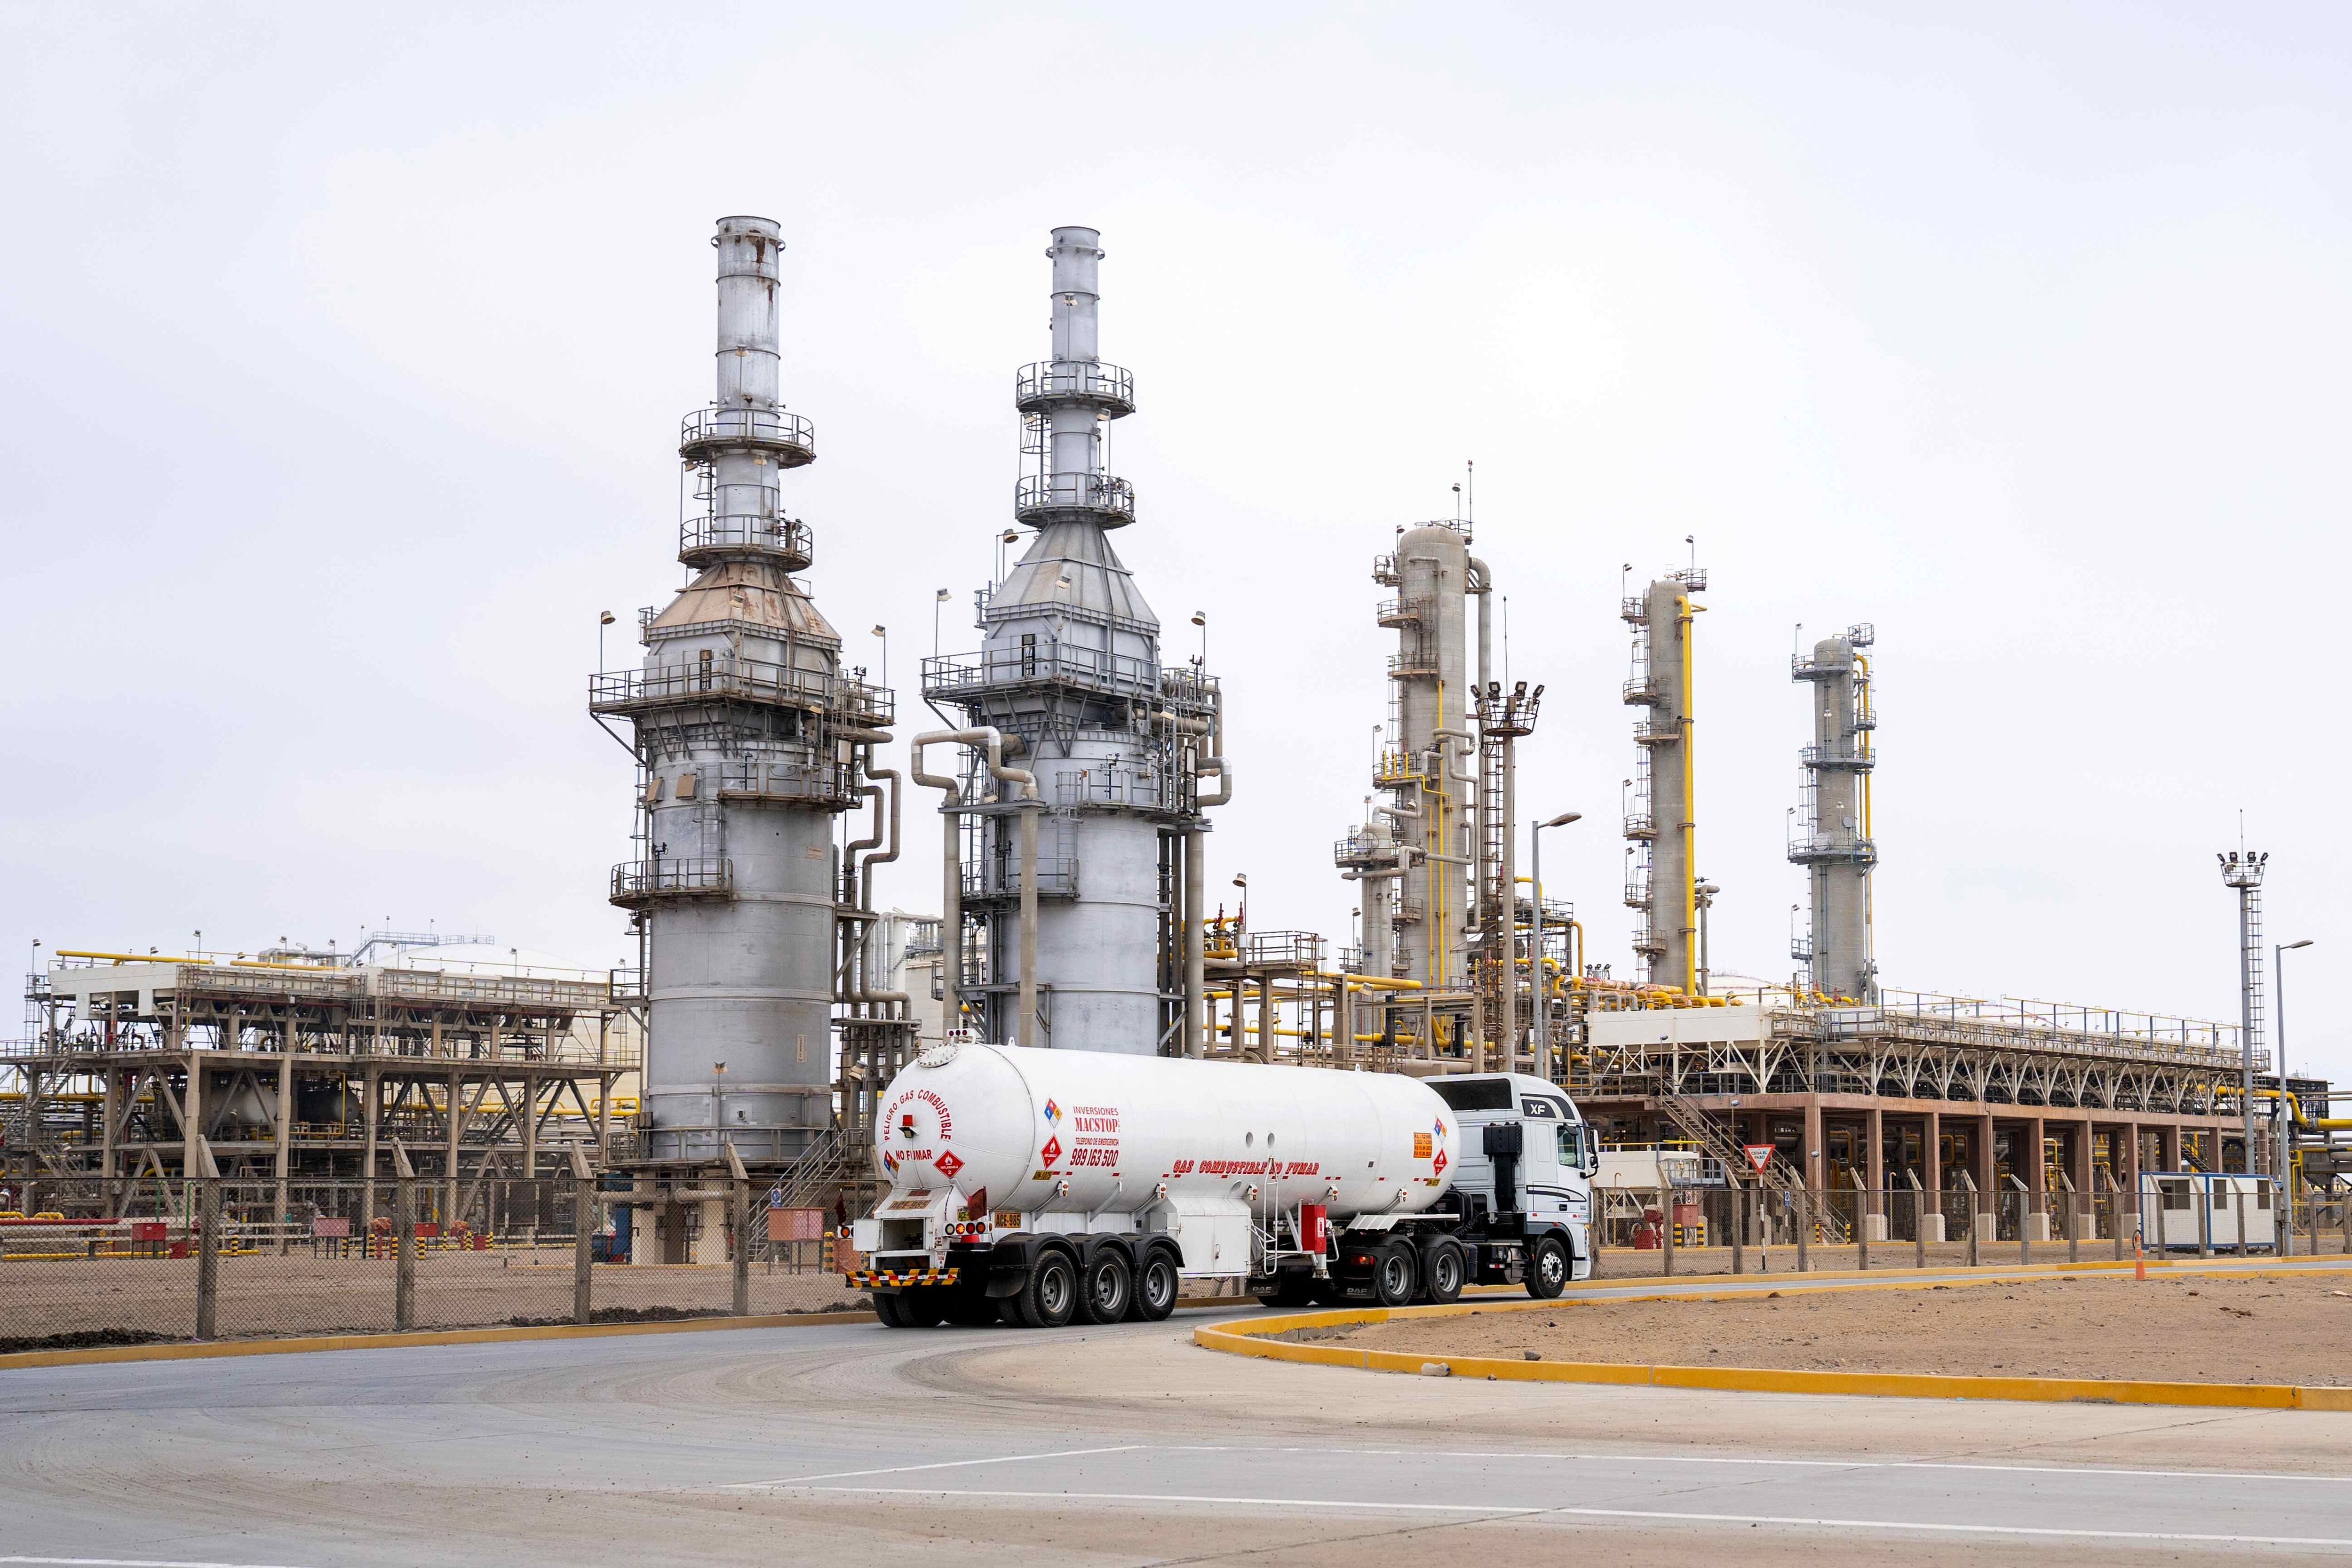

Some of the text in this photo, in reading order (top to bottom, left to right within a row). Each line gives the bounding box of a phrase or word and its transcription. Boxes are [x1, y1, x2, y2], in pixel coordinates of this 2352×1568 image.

[884, 1090, 952, 1140] PELIGRO GAS COMBUSTIBLE
[1073, 1106, 1119, 1115] INVERSIONES
[1530, 1104, 1545, 1114] XF
[1075, 1117, 1118, 1133] MACSTOP
[896, 1149, 933, 1160] NO FUMAR
[1070, 1148, 1119, 1167] 989 163 500
[1173, 1160, 1194, 1173] GAS
[1199, 1160, 1267, 1175] COMBUSTIBLE
[1285, 1162, 1319, 1175] FUMAR
[891, 1200, 926, 1210] ACE-985
[996, 1213, 1020, 1227] ACE-985
